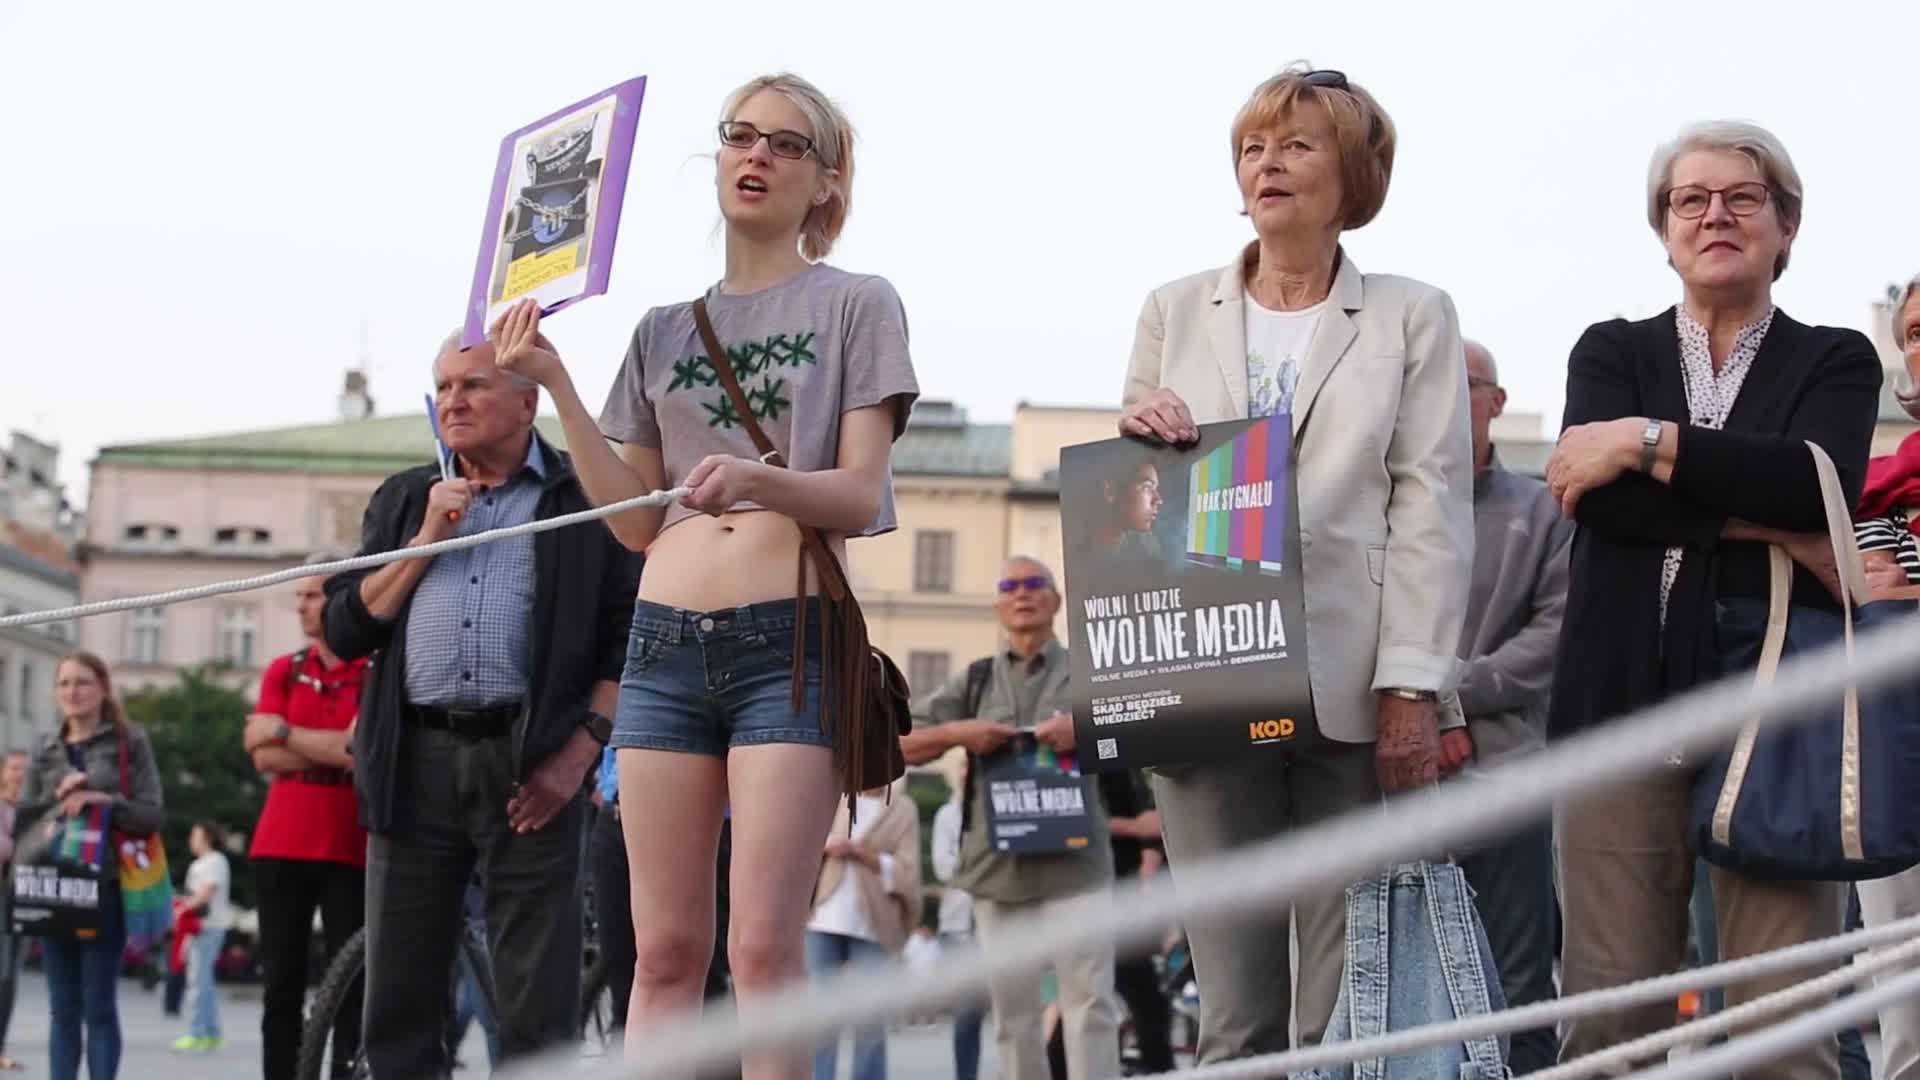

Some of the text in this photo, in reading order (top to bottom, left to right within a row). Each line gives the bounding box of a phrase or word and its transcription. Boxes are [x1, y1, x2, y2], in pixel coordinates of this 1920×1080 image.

[1197, 480, 1272, 513] BRAK SYGNAŁU
[1084, 588, 1182, 619] WOLNI LUDZIE
[1086, 599, 1287, 670] WOLNE MEDIA
[1090, 651, 1288, 682] WOLNE MEDIA WŁASNA OPINIA DEMOKRACJA
[1092, 695, 1182, 716] SKĄD BĘDZIESZ
[1093, 709, 1156, 726] WIEDZIEĆ?
[1249, 718, 1295, 739] KOD
